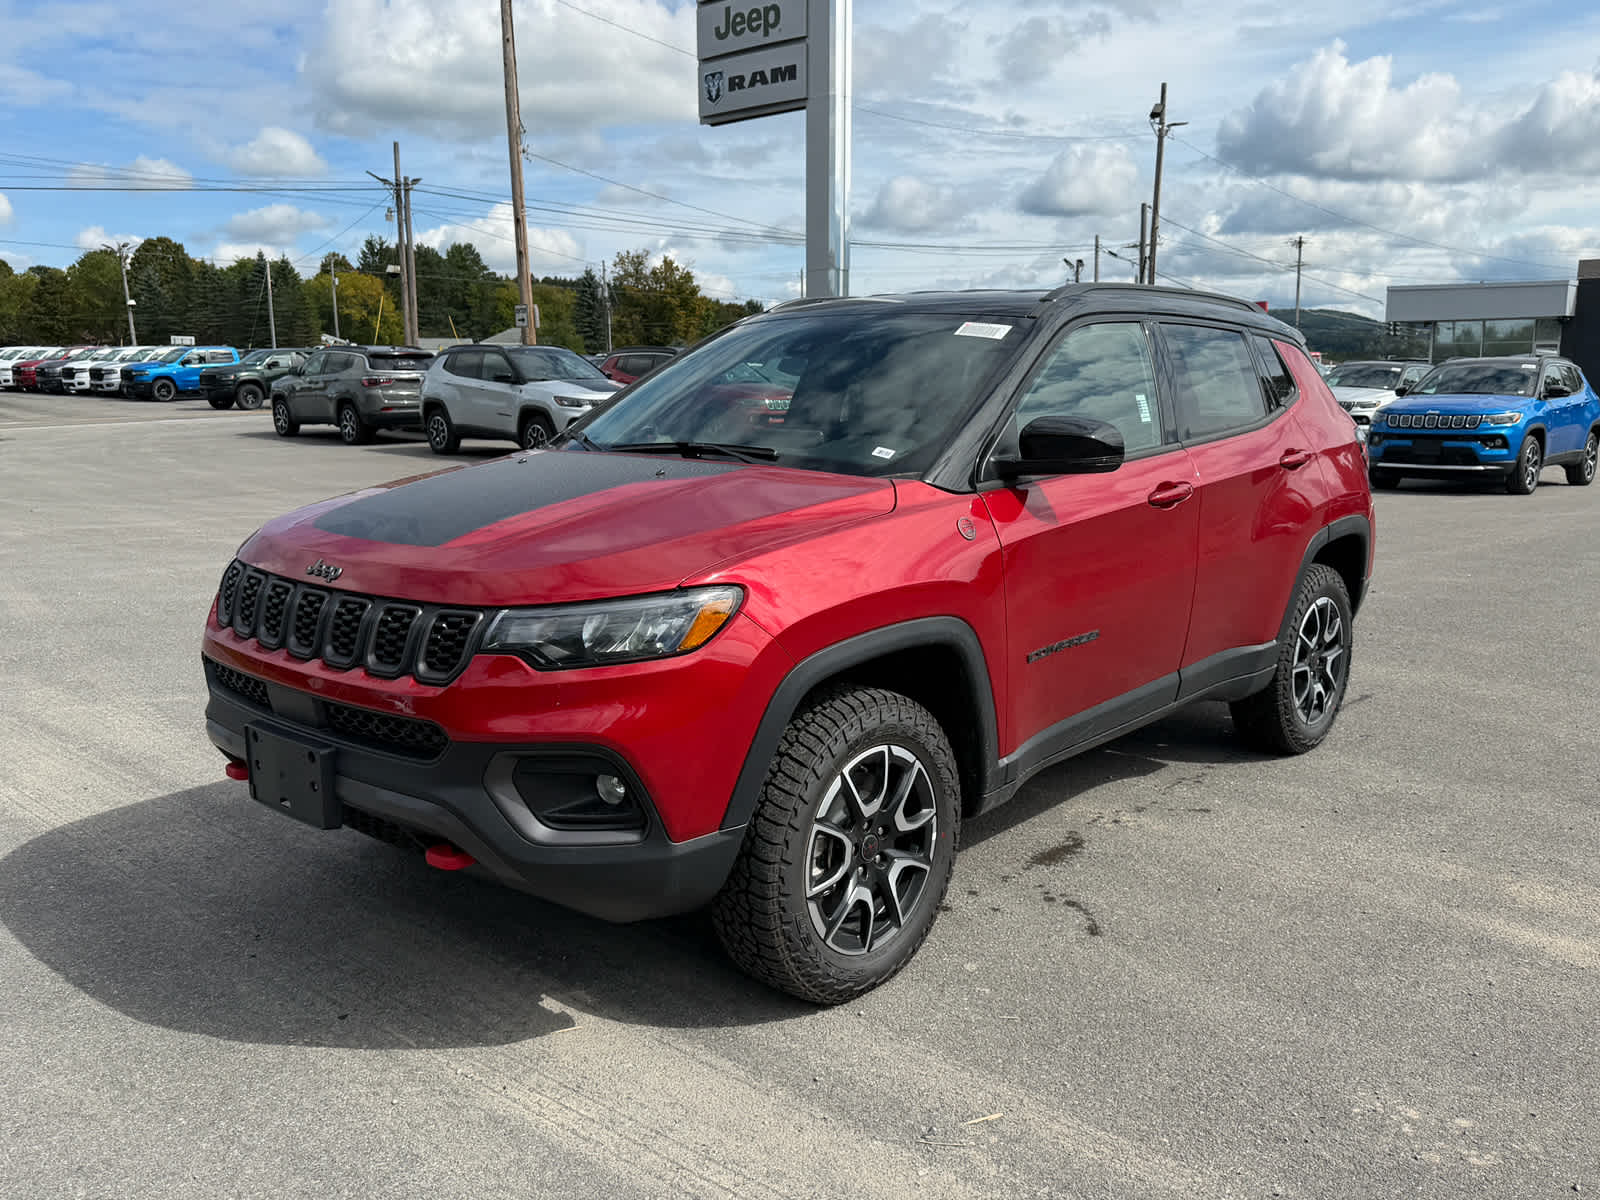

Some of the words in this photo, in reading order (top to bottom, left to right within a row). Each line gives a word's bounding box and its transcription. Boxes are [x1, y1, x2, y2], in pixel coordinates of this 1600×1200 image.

[714, 4, 781, 40] Jeep
[728, 64, 797, 92] RAM
[306, 558, 344, 583] Jeep
